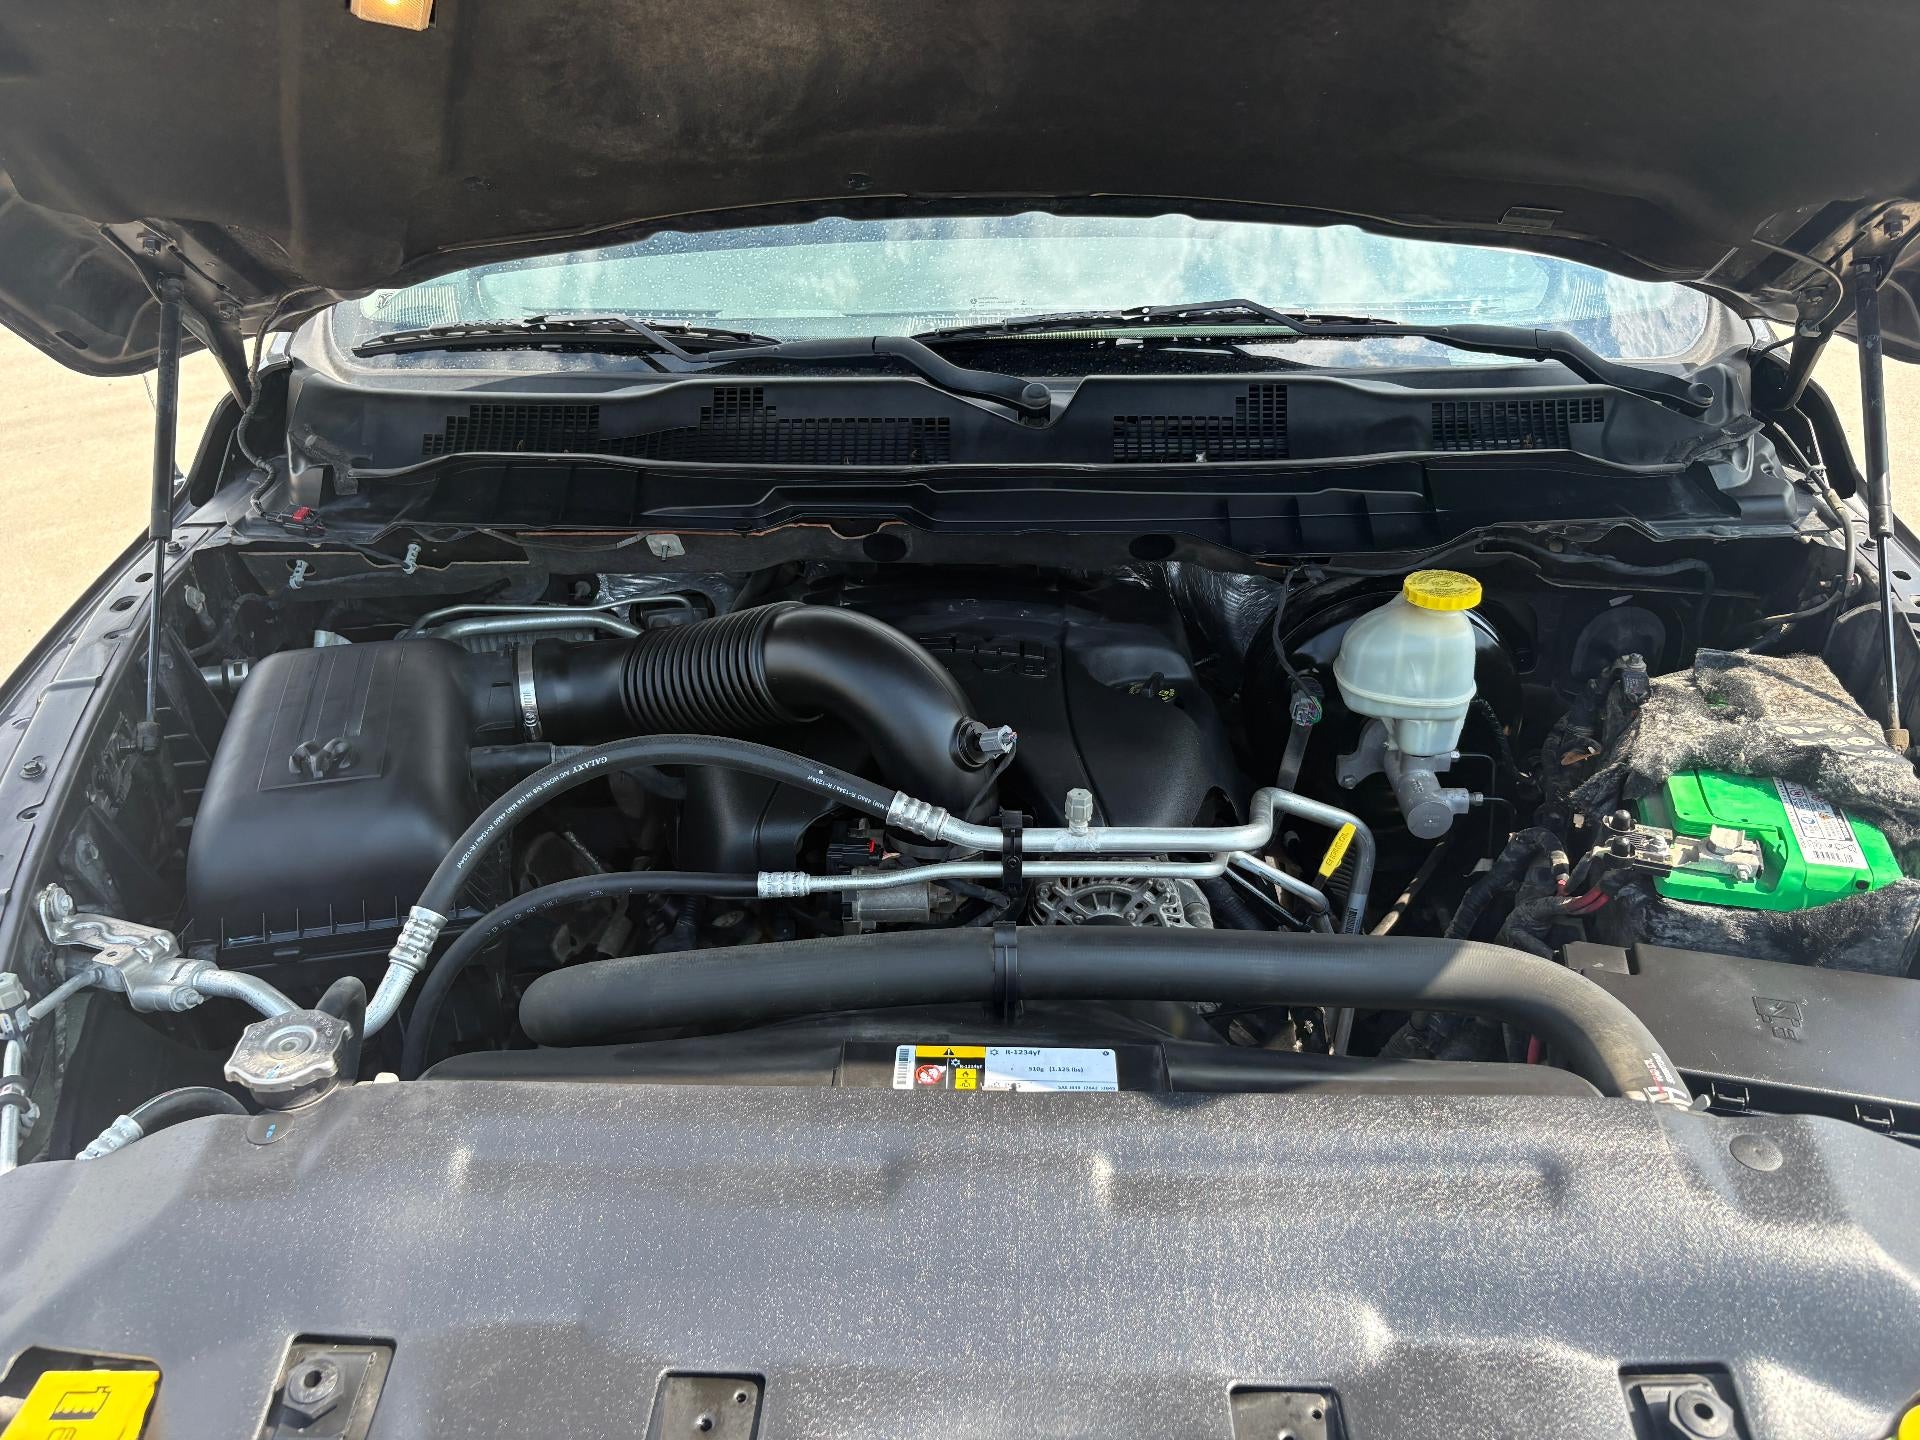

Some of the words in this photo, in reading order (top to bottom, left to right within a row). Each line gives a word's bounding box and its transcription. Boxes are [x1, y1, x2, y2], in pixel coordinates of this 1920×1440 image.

[572, 756, 608, 773] GALAXY
[559, 770, 570, 779] A/C
[542, 776, 559, 789] HOSE
[837, 786, 856, 798] R-134a
[1005, 1049, 1041, 1057] R-1234yf
